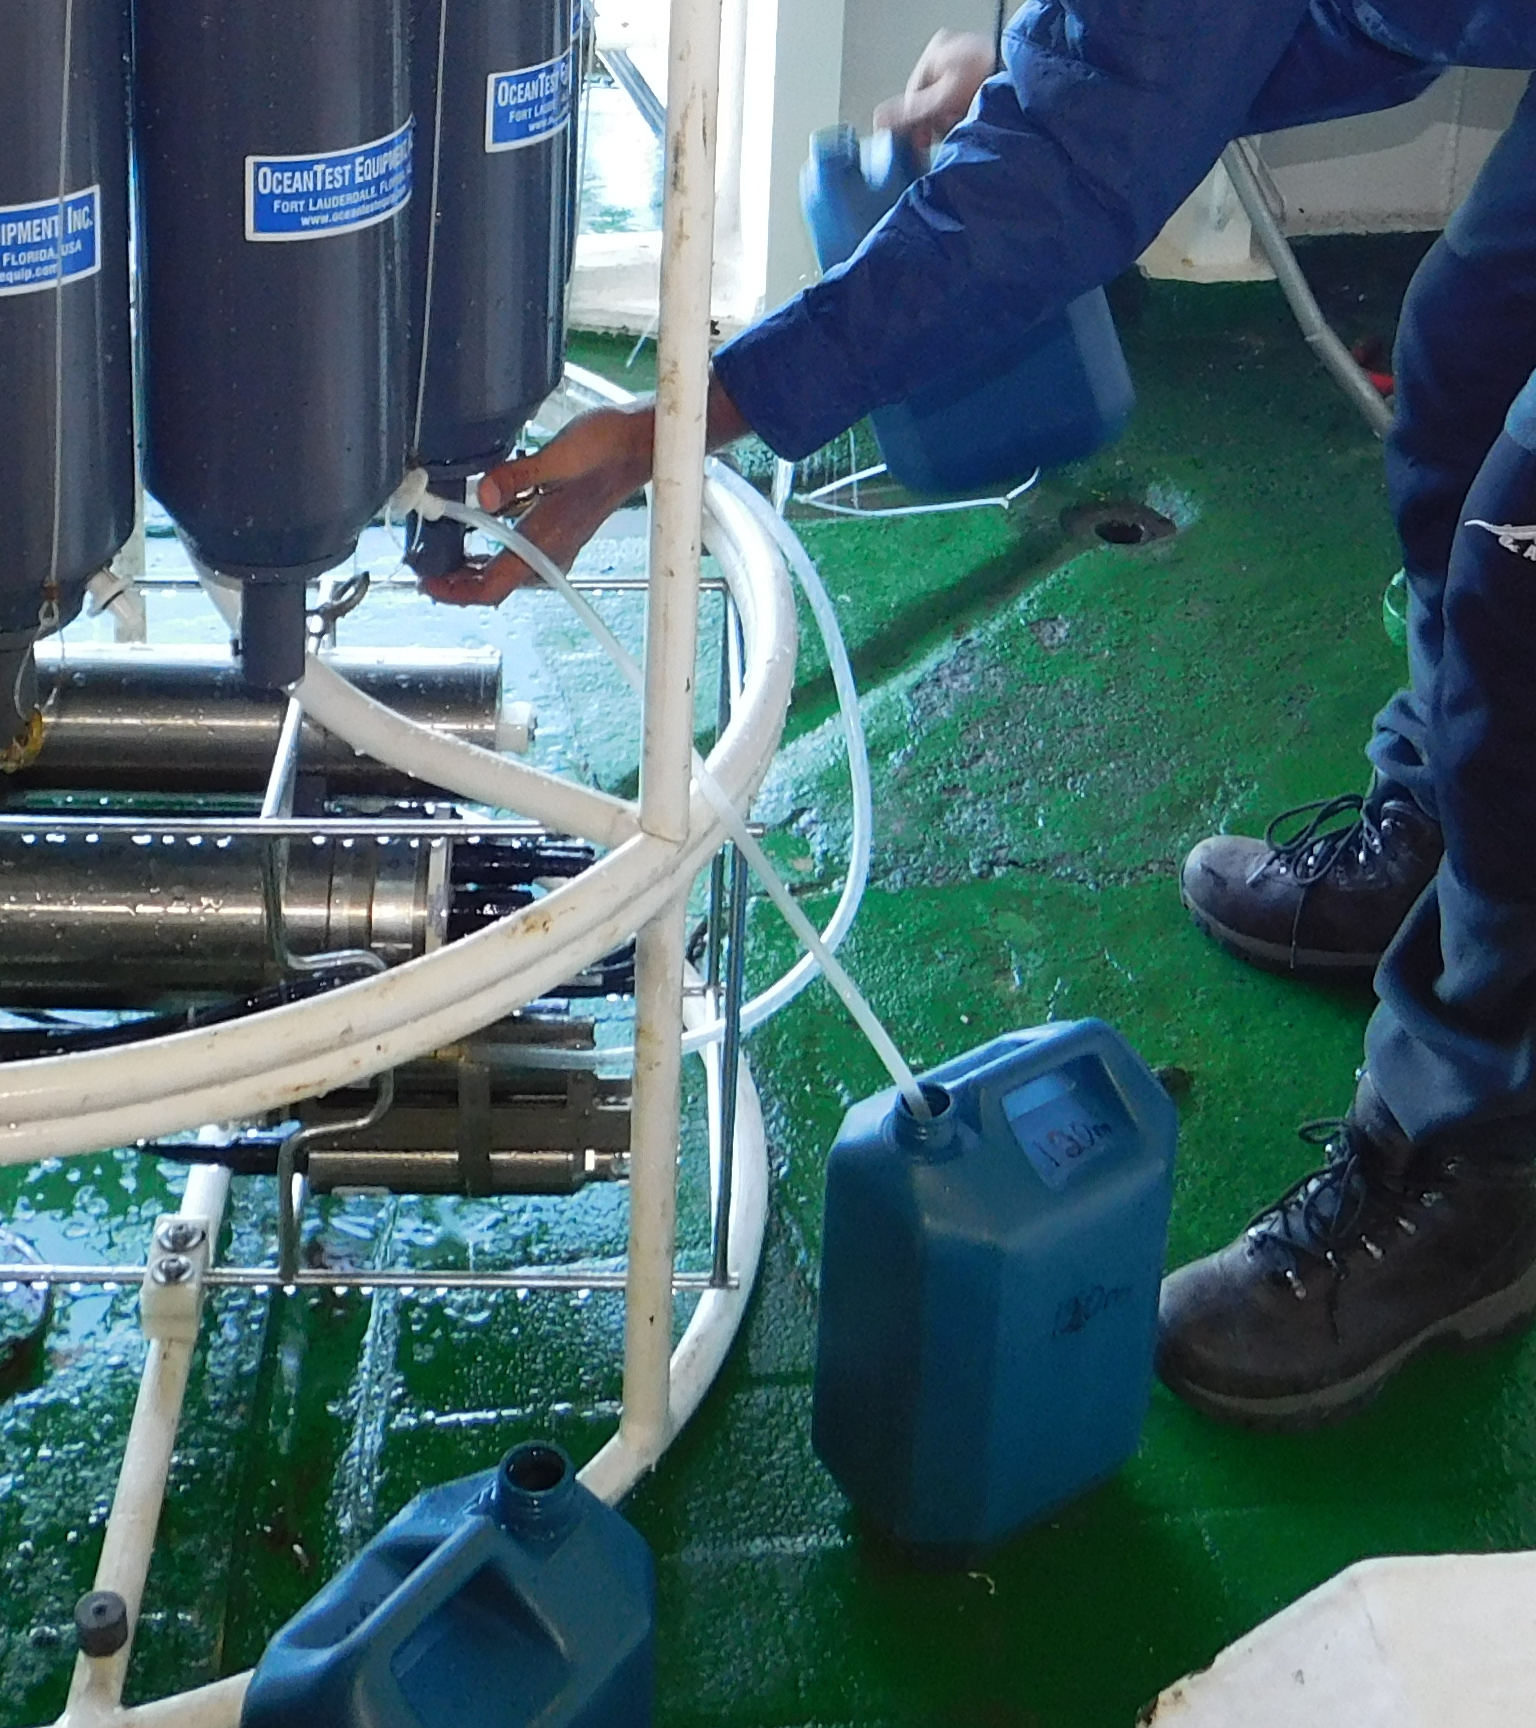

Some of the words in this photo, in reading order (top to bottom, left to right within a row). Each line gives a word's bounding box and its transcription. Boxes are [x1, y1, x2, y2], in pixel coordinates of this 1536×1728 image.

[273, 199, 306, 213] FORT
[67, 205, 94, 234] INC.
[60, 238, 83, 257] USA
